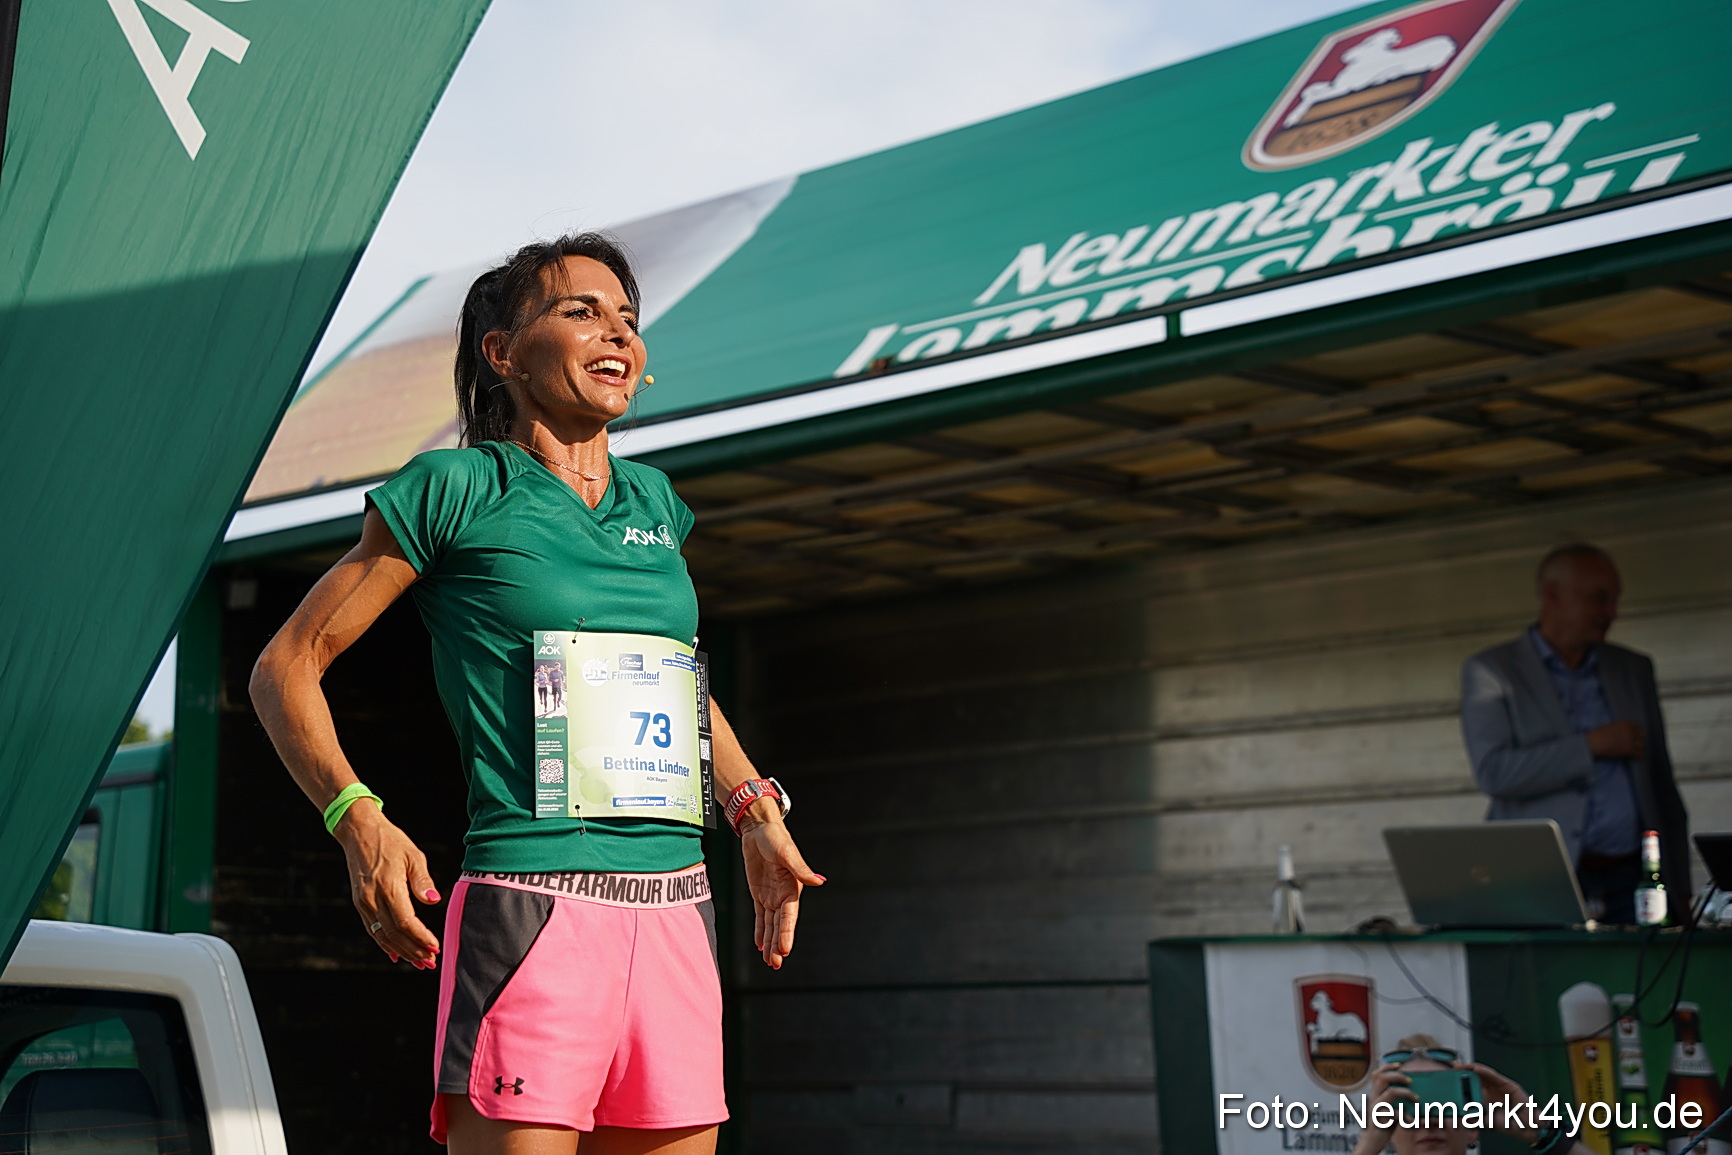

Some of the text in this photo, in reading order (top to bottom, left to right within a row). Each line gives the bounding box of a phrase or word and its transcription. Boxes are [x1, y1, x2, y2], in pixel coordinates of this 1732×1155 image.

[973, 102, 1616, 306] Neumarkter
[622, 526, 664, 546] AOK
[538, 645, 561, 655] AOK
[611, 671, 660, 680] Firmenlauf
[629, 711, 671, 748] 73
[603, 756, 690, 777] Bettina Lindner
[702, 765, 711, 815] HILTL
[575, 873, 663, 905] ARMOUR
[667, 870, 707, 903] UNDER
